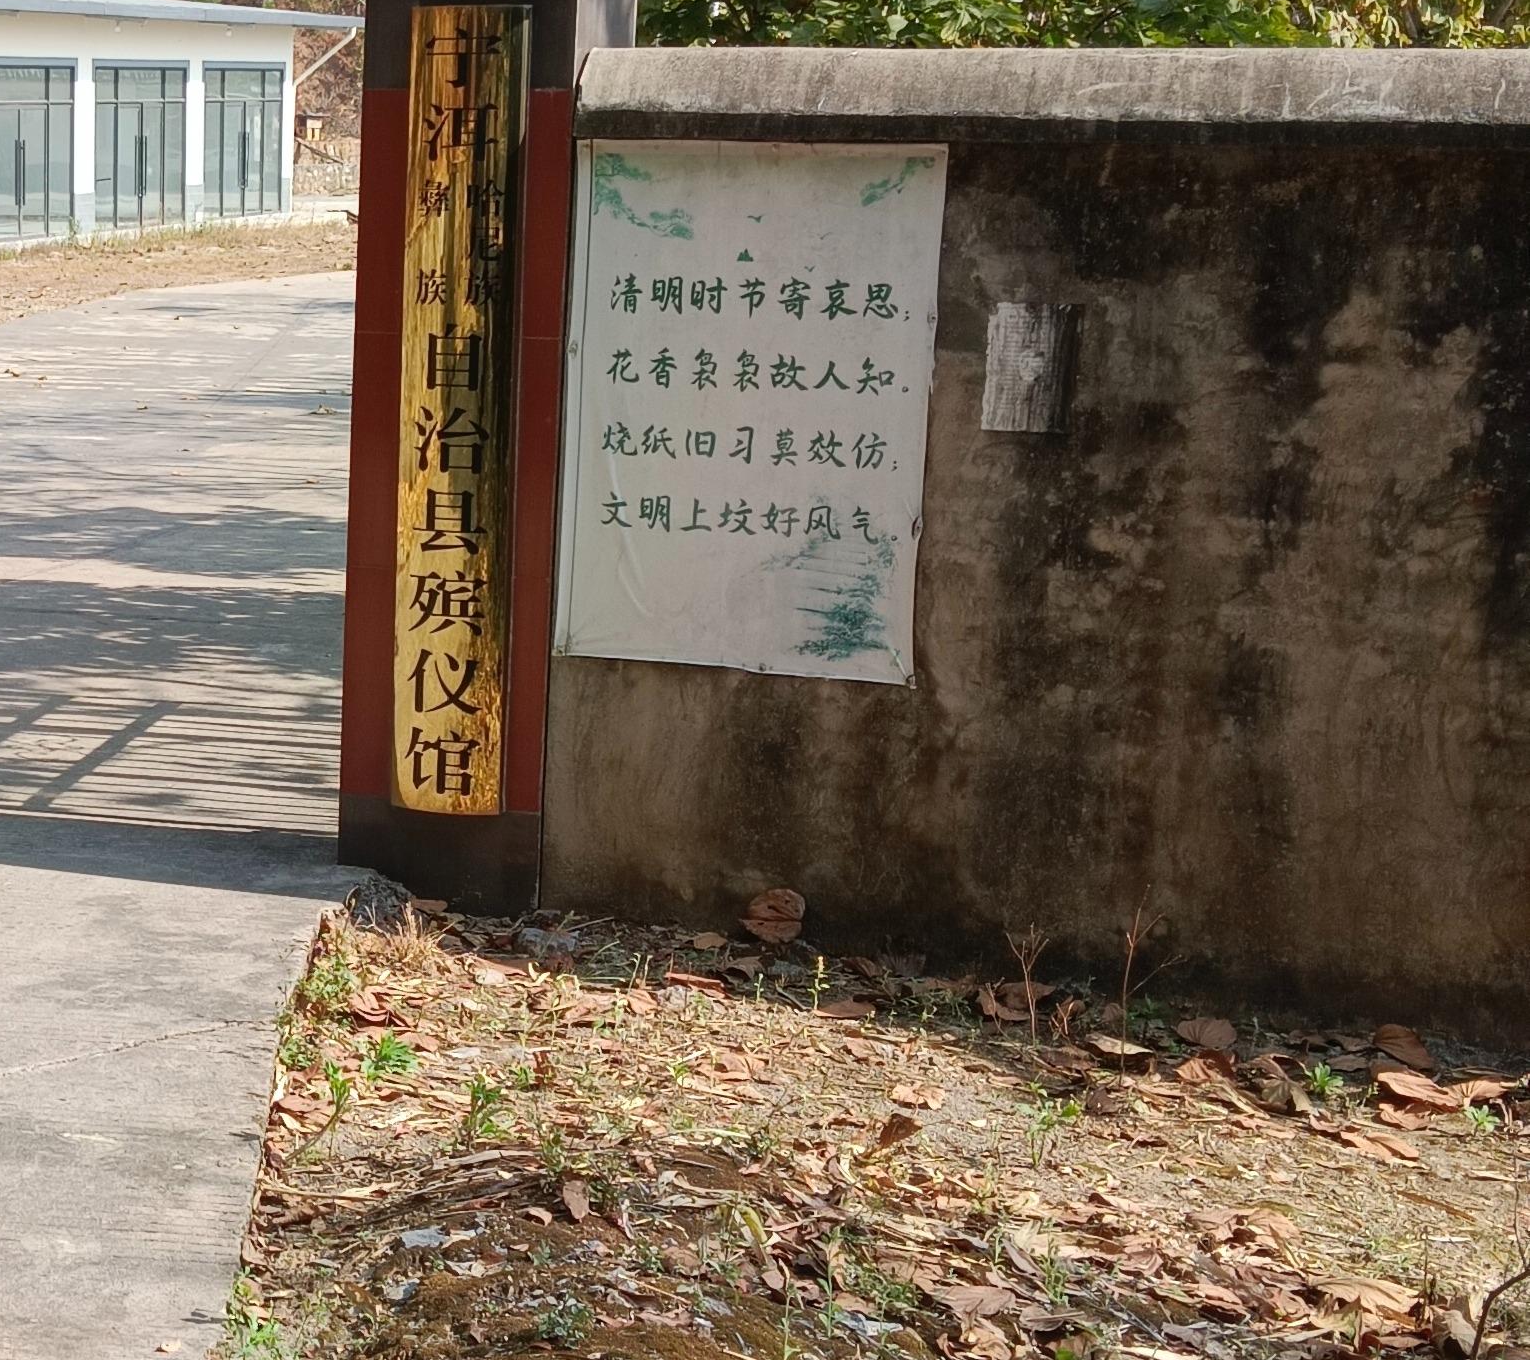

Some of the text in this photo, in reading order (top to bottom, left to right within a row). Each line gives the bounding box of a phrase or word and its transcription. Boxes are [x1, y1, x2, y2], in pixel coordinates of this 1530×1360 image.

[404, 324, 491, 797] 自治县殡仪馆
